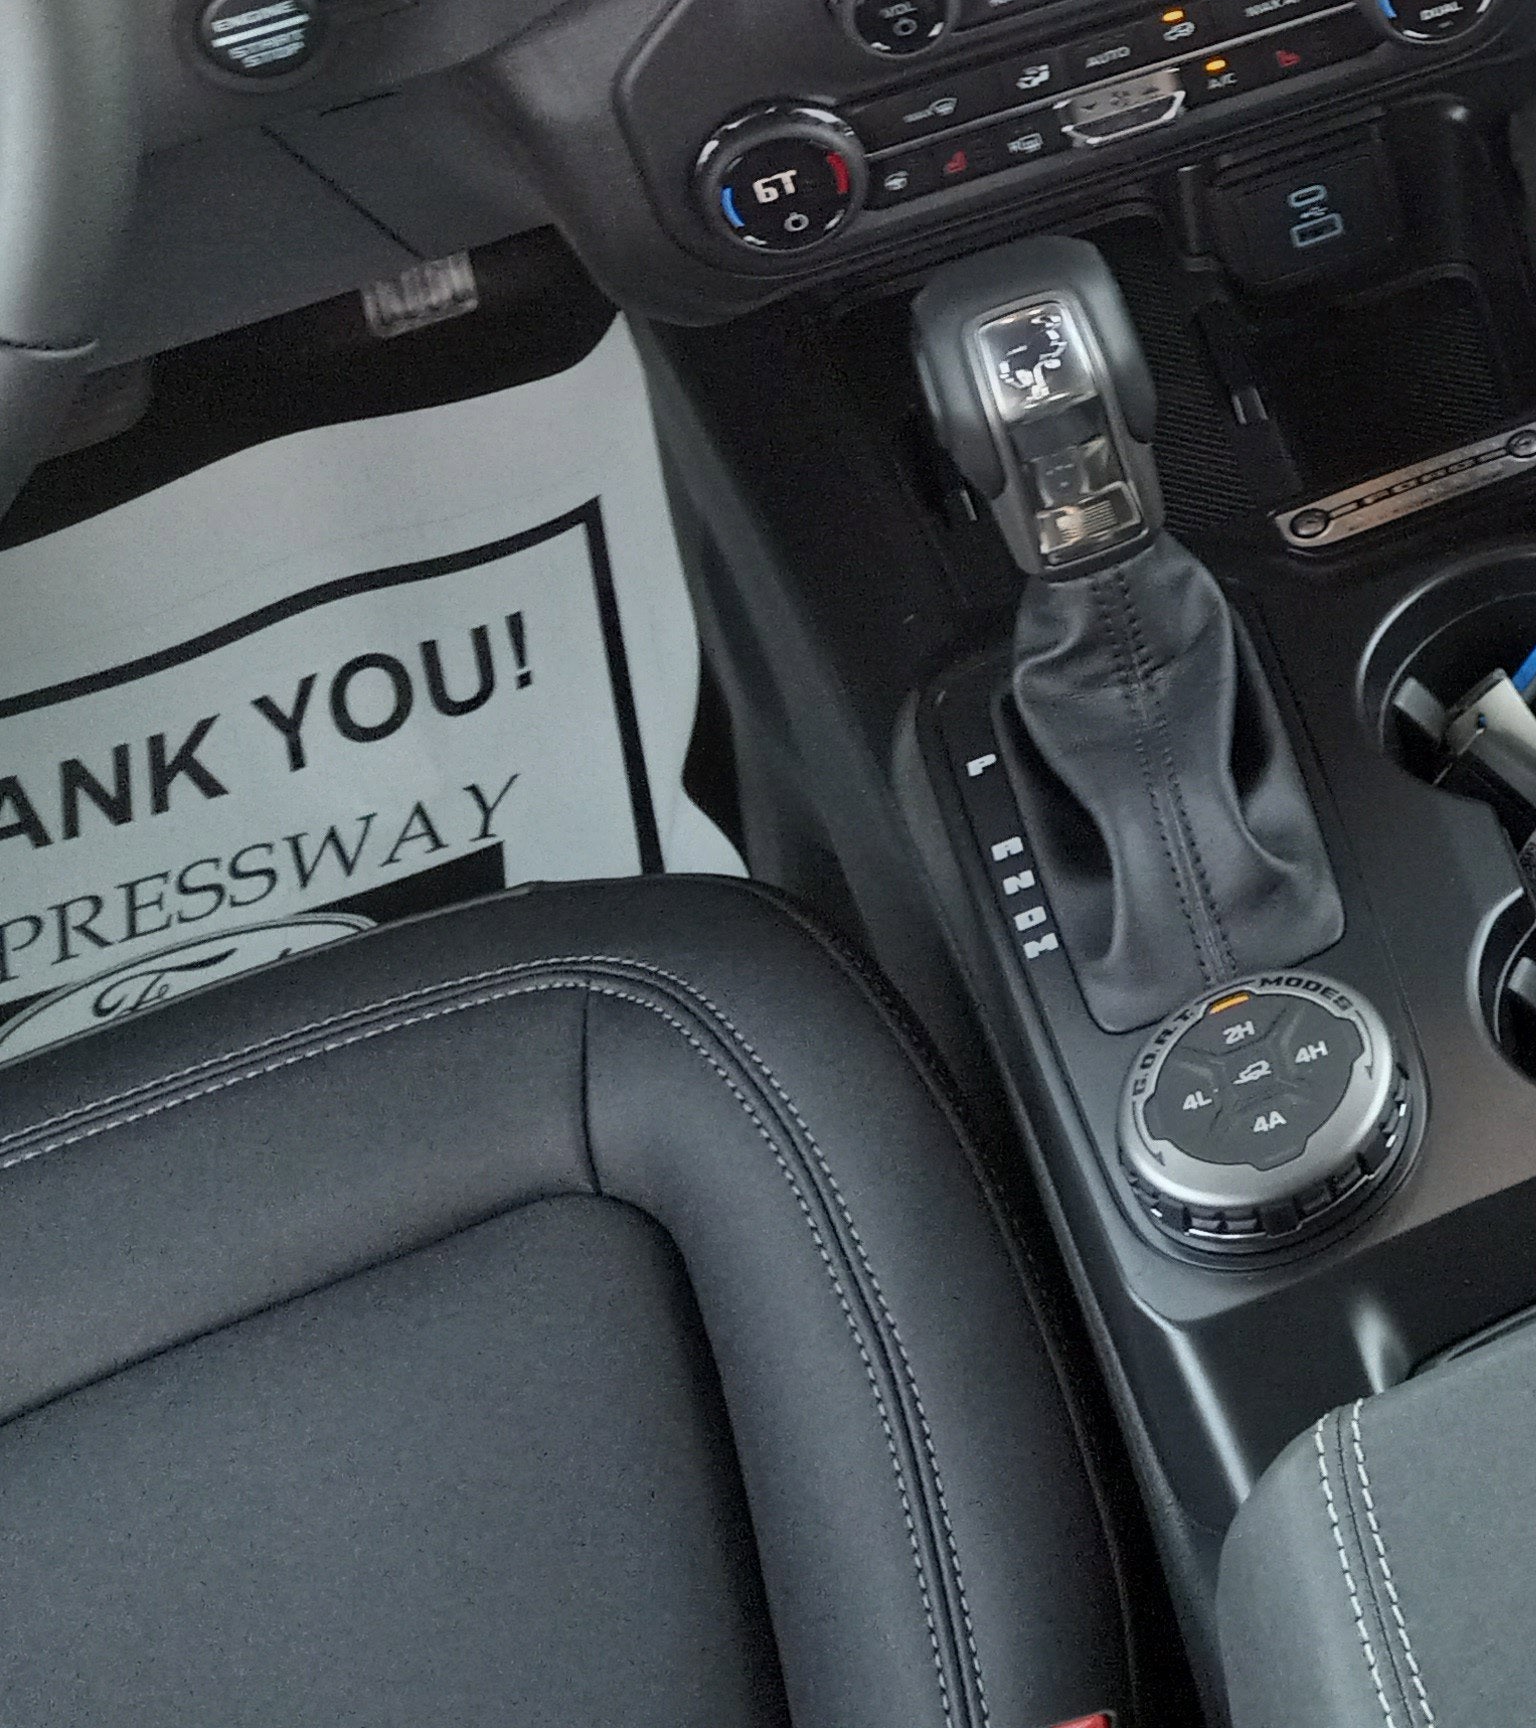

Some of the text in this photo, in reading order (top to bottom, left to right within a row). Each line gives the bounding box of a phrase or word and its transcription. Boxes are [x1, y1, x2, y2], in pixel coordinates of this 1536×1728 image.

[211, 0, 299, 33] ENGINE
[879, 1, 918, 19] VOL
[1419, 1, 1464, 21] DUAL
[227, 28, 307, 60] START
[241, 41, 306, 69] STOP
[1085, 46, 1131, 69] AUTO
[1207, 72, 1238, 90] A/C
[0, 611, 534, 850] ANK YOU!
[967, 753, 997, 777] P
[0, 773, 521, 985] PRESSWAY
[1002, 870, 1035, 895] N
[1014, 906, 1047, 932] D
[1023, 933, 1059, 959] M
[1258, 975, 1354, 1012] MODES
[1223, 1020, 1255, 1045] 2H
[1295, 1040, 1328, 1064] 4H
[1182, 1090, 1213, 1110] 4L
[1252, 1111, 1287, 1133] 4A
